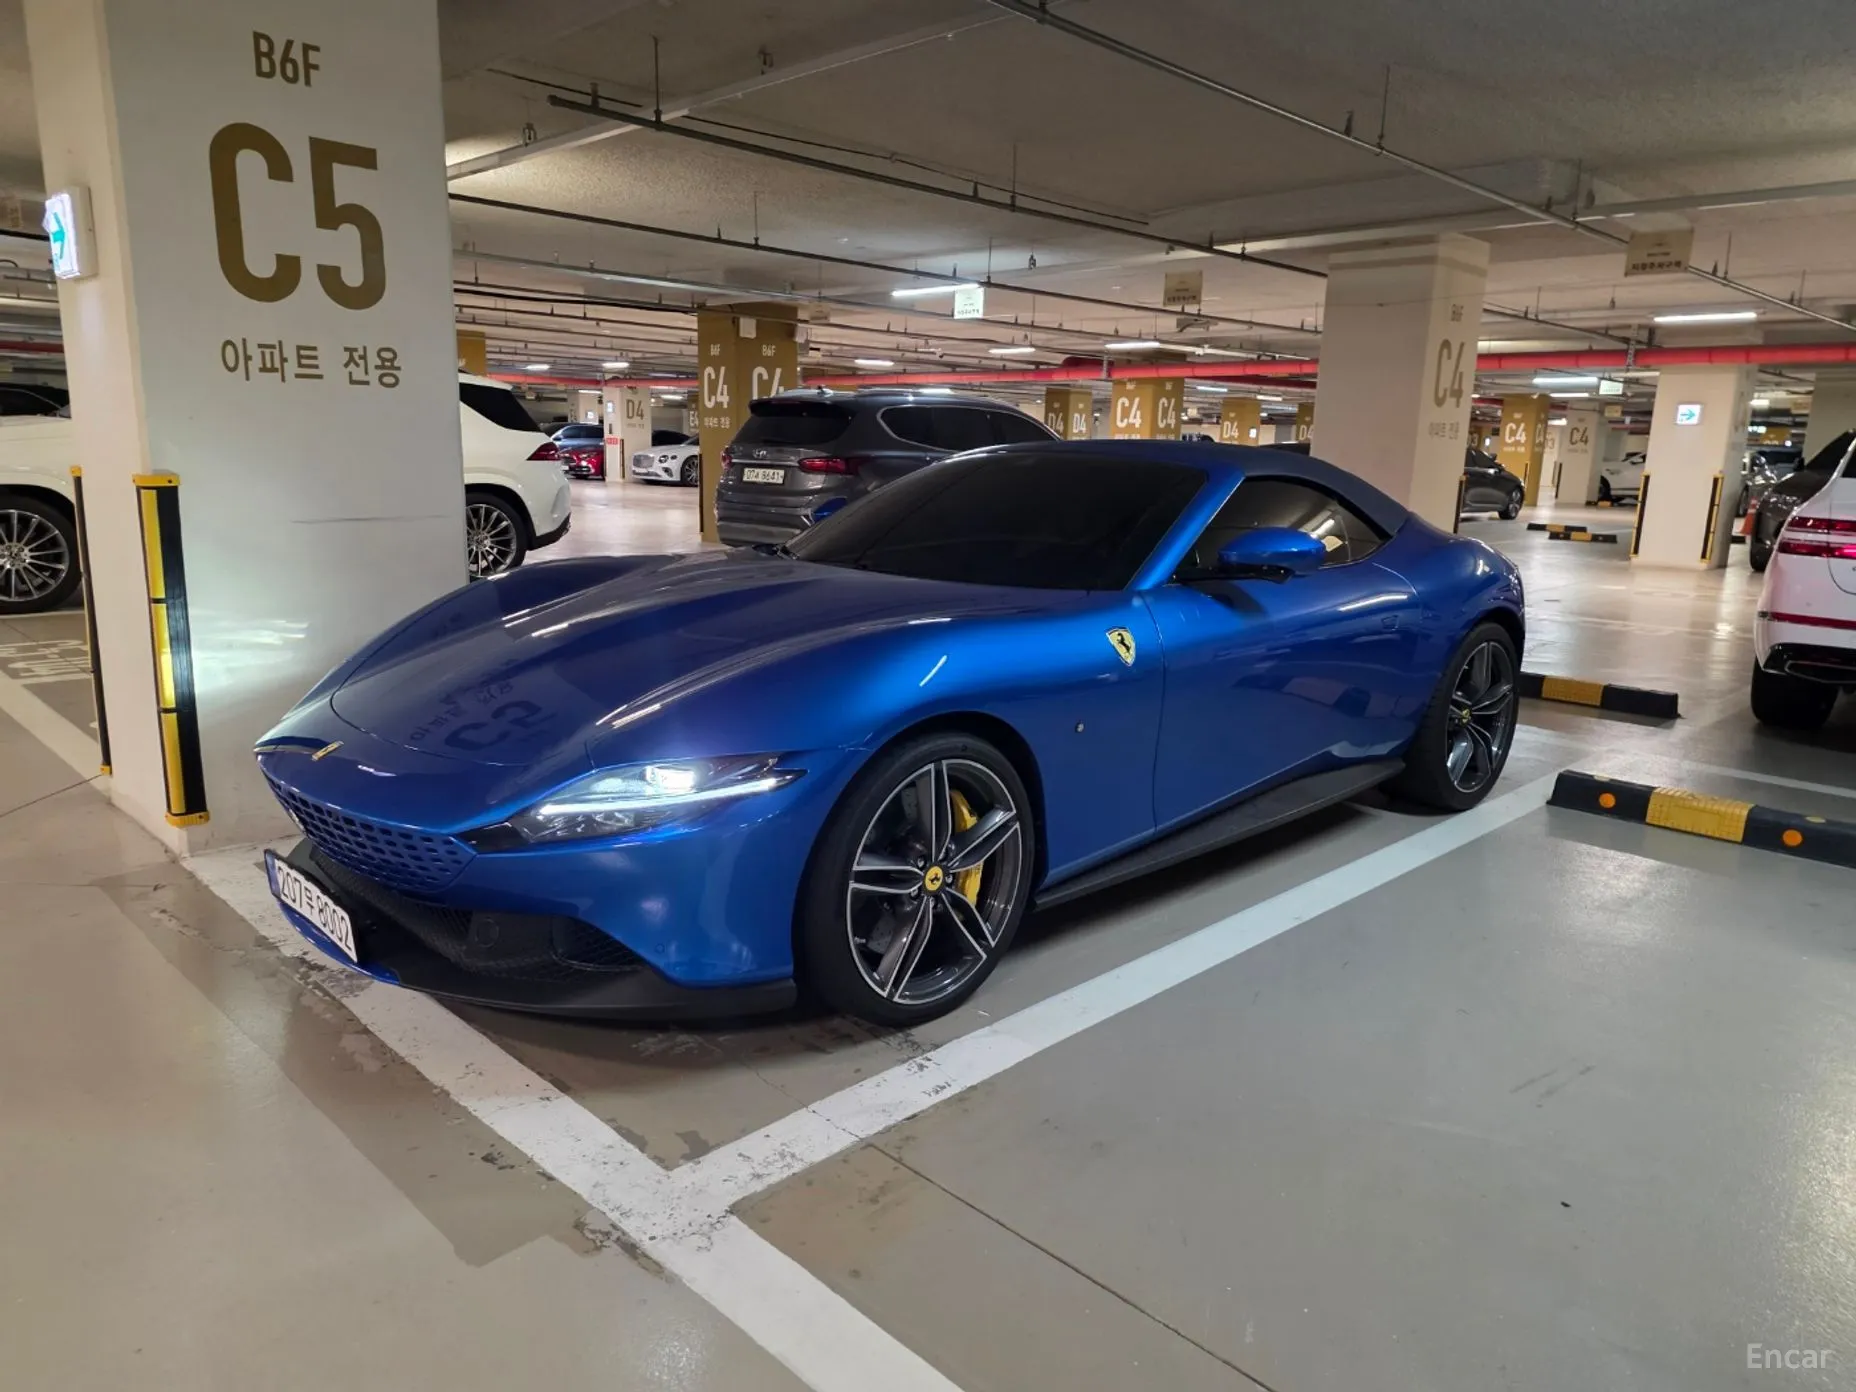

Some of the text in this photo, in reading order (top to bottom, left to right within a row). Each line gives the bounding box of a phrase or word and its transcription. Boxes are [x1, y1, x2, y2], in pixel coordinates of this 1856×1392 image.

[252, 30, 321, 87] B6F
[209, 122, 387, 310] C5
[221, 337, 402, 389] 아파트 전용
[1434, 338, 1465, 408] C4
[704, 366, 729, 408] C4
[625, 399, 645, 420] D4
[1072, 413, 1086, 433] D4
[1116, 397, 1141, 428] C4
[1158, 397, 1175, 429] C4
[1223, 421, 1239, 439] D4
[1505, 422, 1526, 443] C4
[1569, 427, 1589, 445] C4
[317, 895, 352, 952] 8002
